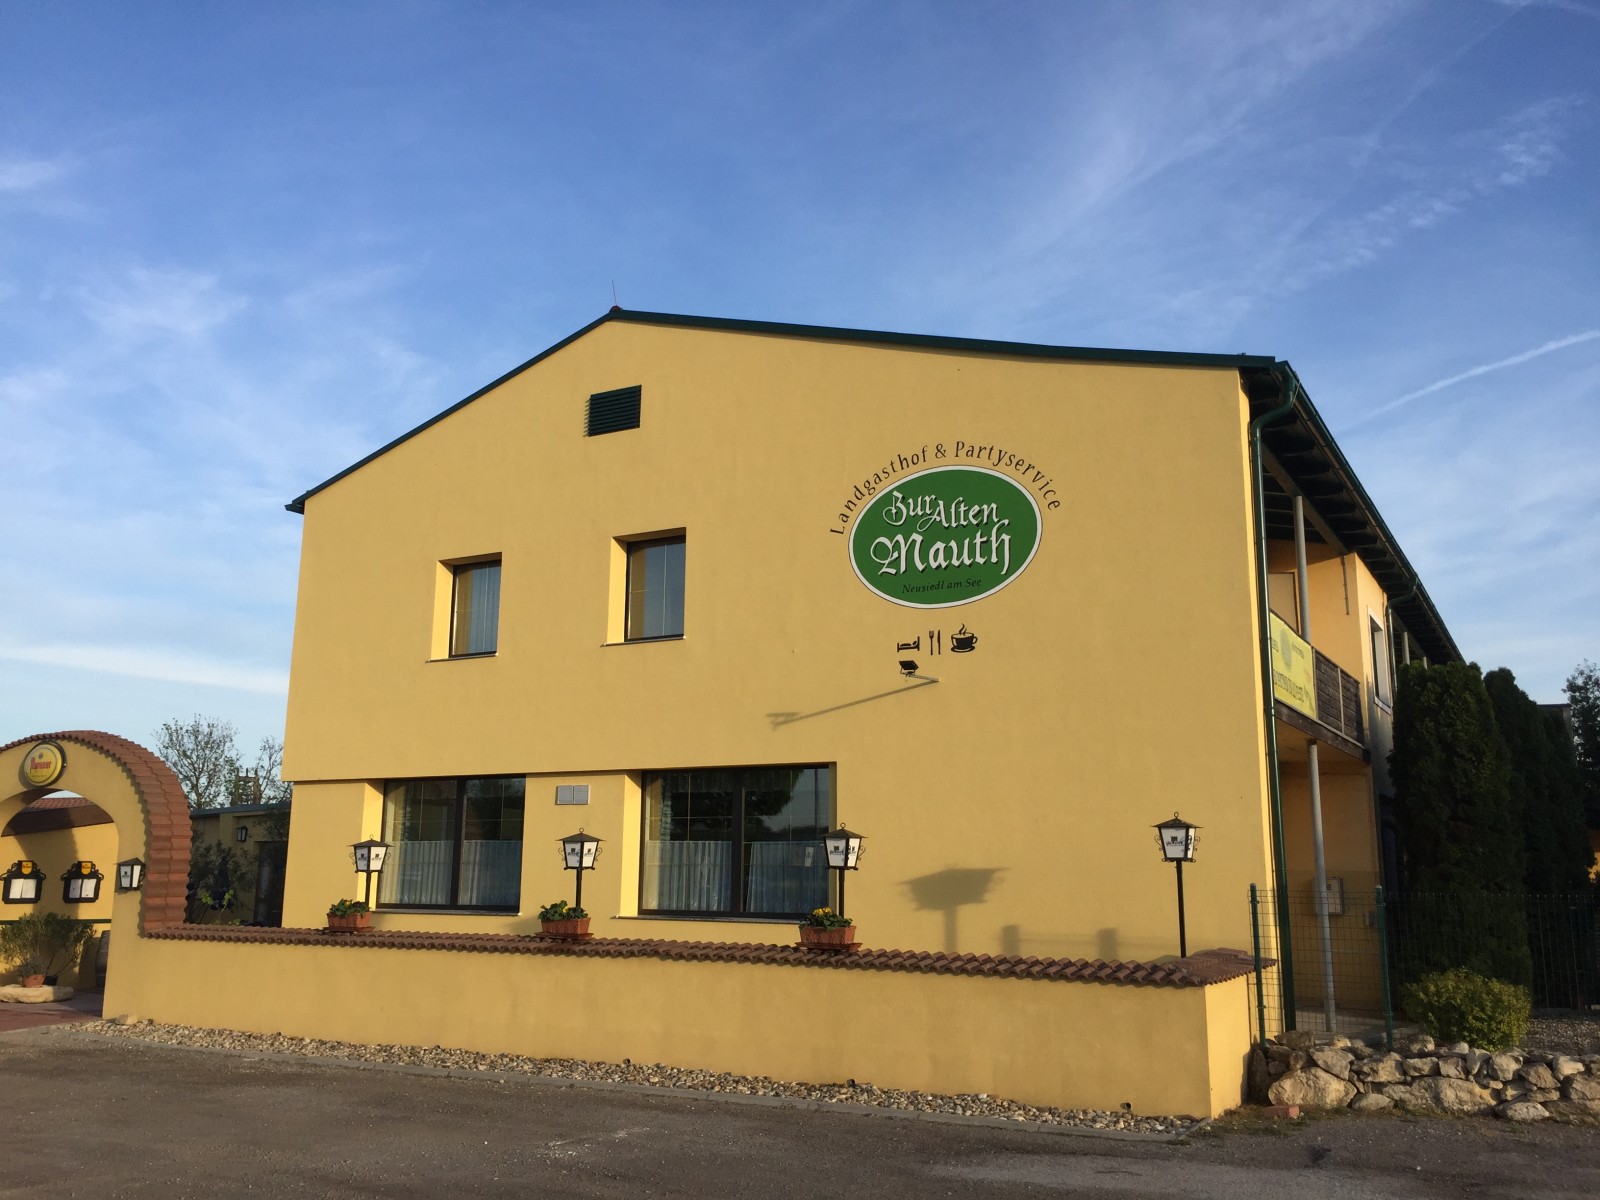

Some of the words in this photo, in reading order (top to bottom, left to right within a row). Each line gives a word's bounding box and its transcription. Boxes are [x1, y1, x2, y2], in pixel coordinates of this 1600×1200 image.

[830, 445, 928, 535] Landgasthof
[935, 443, 947, 459] &
[955, 440, 1061, 511] Partyservice
[917, 496, 999, 531] Alten
[870, 519, 1011, 576] Mauth
[902, 580, 945, 594] Neusiedl
[947, 581, 962, 590] am
[965, 578, 982, 588] See
